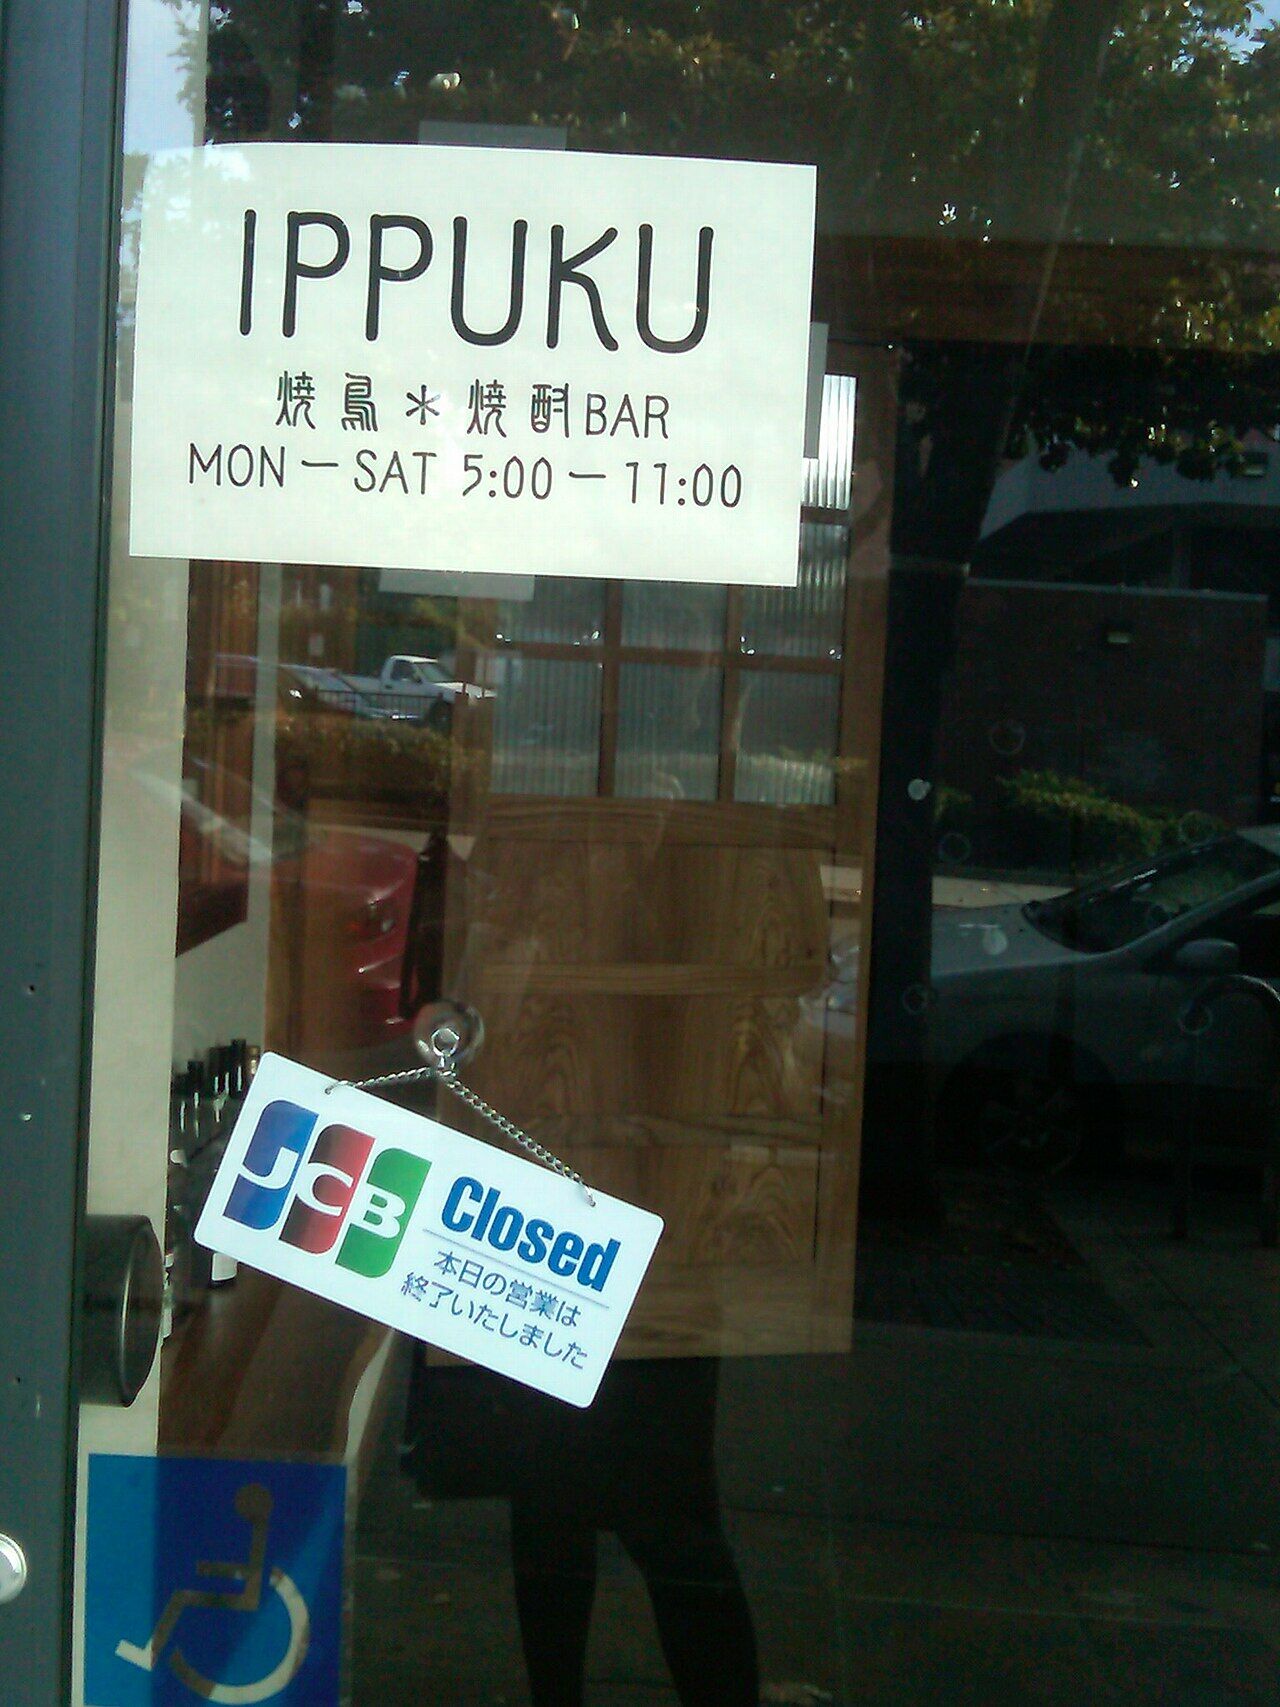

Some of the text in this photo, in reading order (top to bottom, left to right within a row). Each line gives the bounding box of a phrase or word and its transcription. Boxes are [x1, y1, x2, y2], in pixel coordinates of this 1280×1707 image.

[240, 208, 715, 354] IPPUKU
[189, 442, 286, 488] MON
[353, 449, 440, 495] SAT
[462, 454, 553, 499] 5:00
[625, 461, 742, 508] 11:00
[234, 1139, 411, 1246] JCB
[440, 1175, 622, 1293] Closed
[400, 1271, 588, 1370] 終了いたしました
[433, 1250, 582, 1328] 本日の営業は
